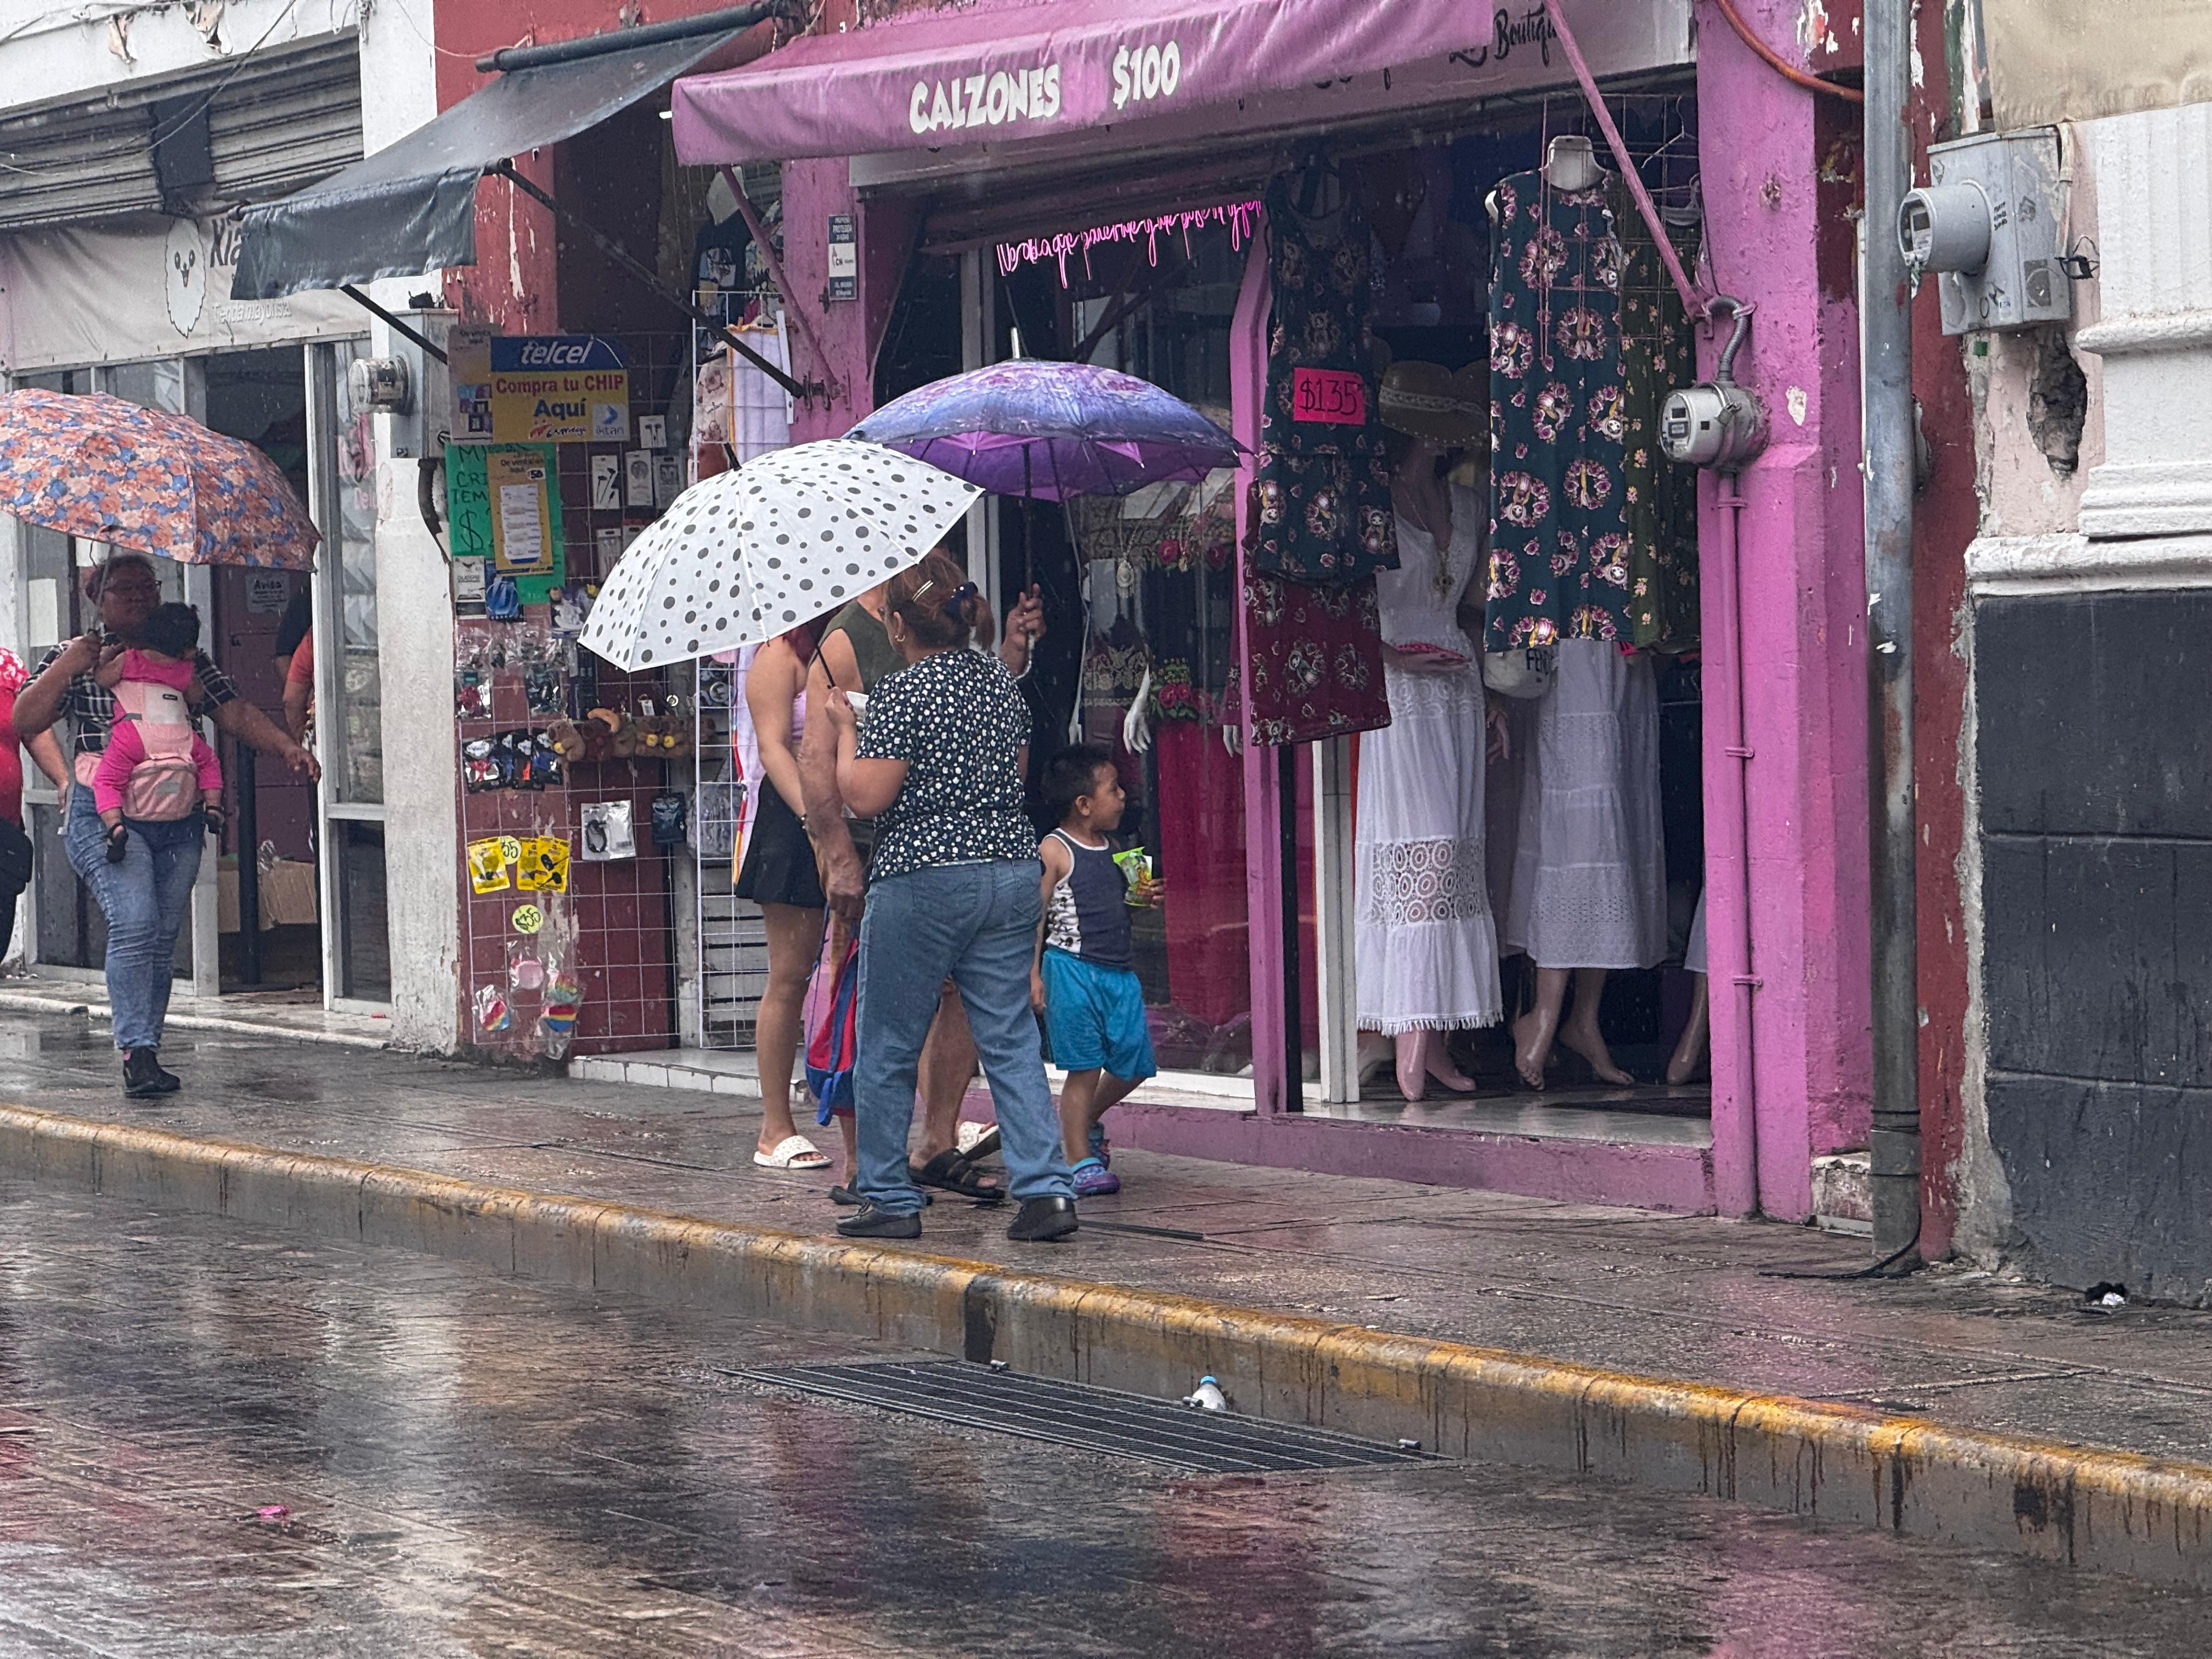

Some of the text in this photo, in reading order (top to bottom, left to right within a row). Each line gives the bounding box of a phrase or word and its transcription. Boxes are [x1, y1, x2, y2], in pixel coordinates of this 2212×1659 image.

[1493, 3, 1558, 67] Boutiqu
[909, 40, 1181, 134] CALZONES $100
[245, 301, 292, 325] mayorista
[521, 338, 594, 365] telcel
[496, 374, 624, 396] Compra tu CHIP
[1299, 377, 1358, 416] $135
[533, 397, 586, 420] Aquí
